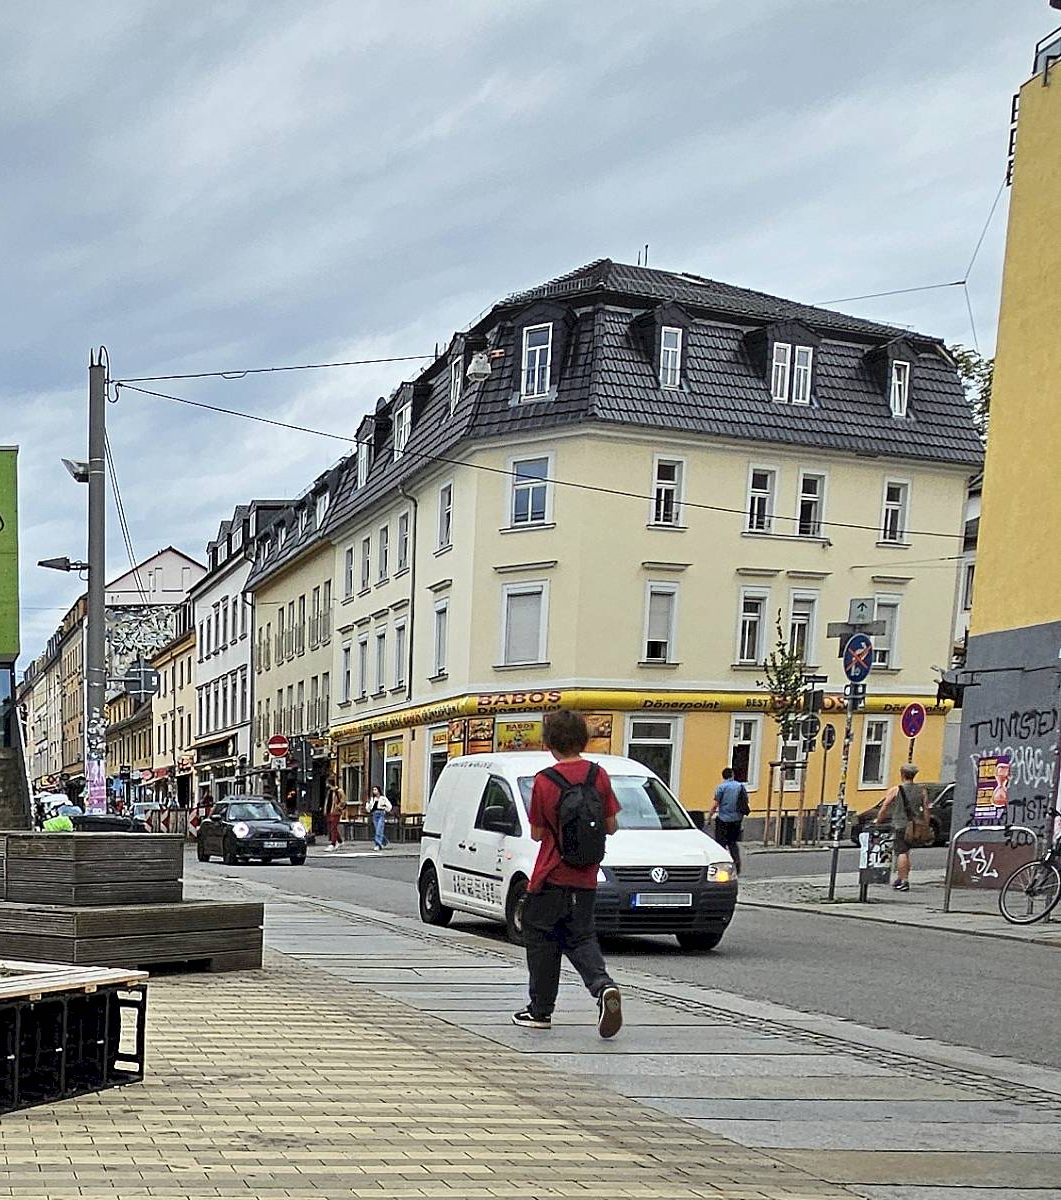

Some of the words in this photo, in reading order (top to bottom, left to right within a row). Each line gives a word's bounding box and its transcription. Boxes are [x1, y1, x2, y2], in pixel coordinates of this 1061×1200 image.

[477, 690, 562, 706] BABOS
[642, 699, 720, 711] Dönerpoint
[745, 698, 768, 708] BEST
